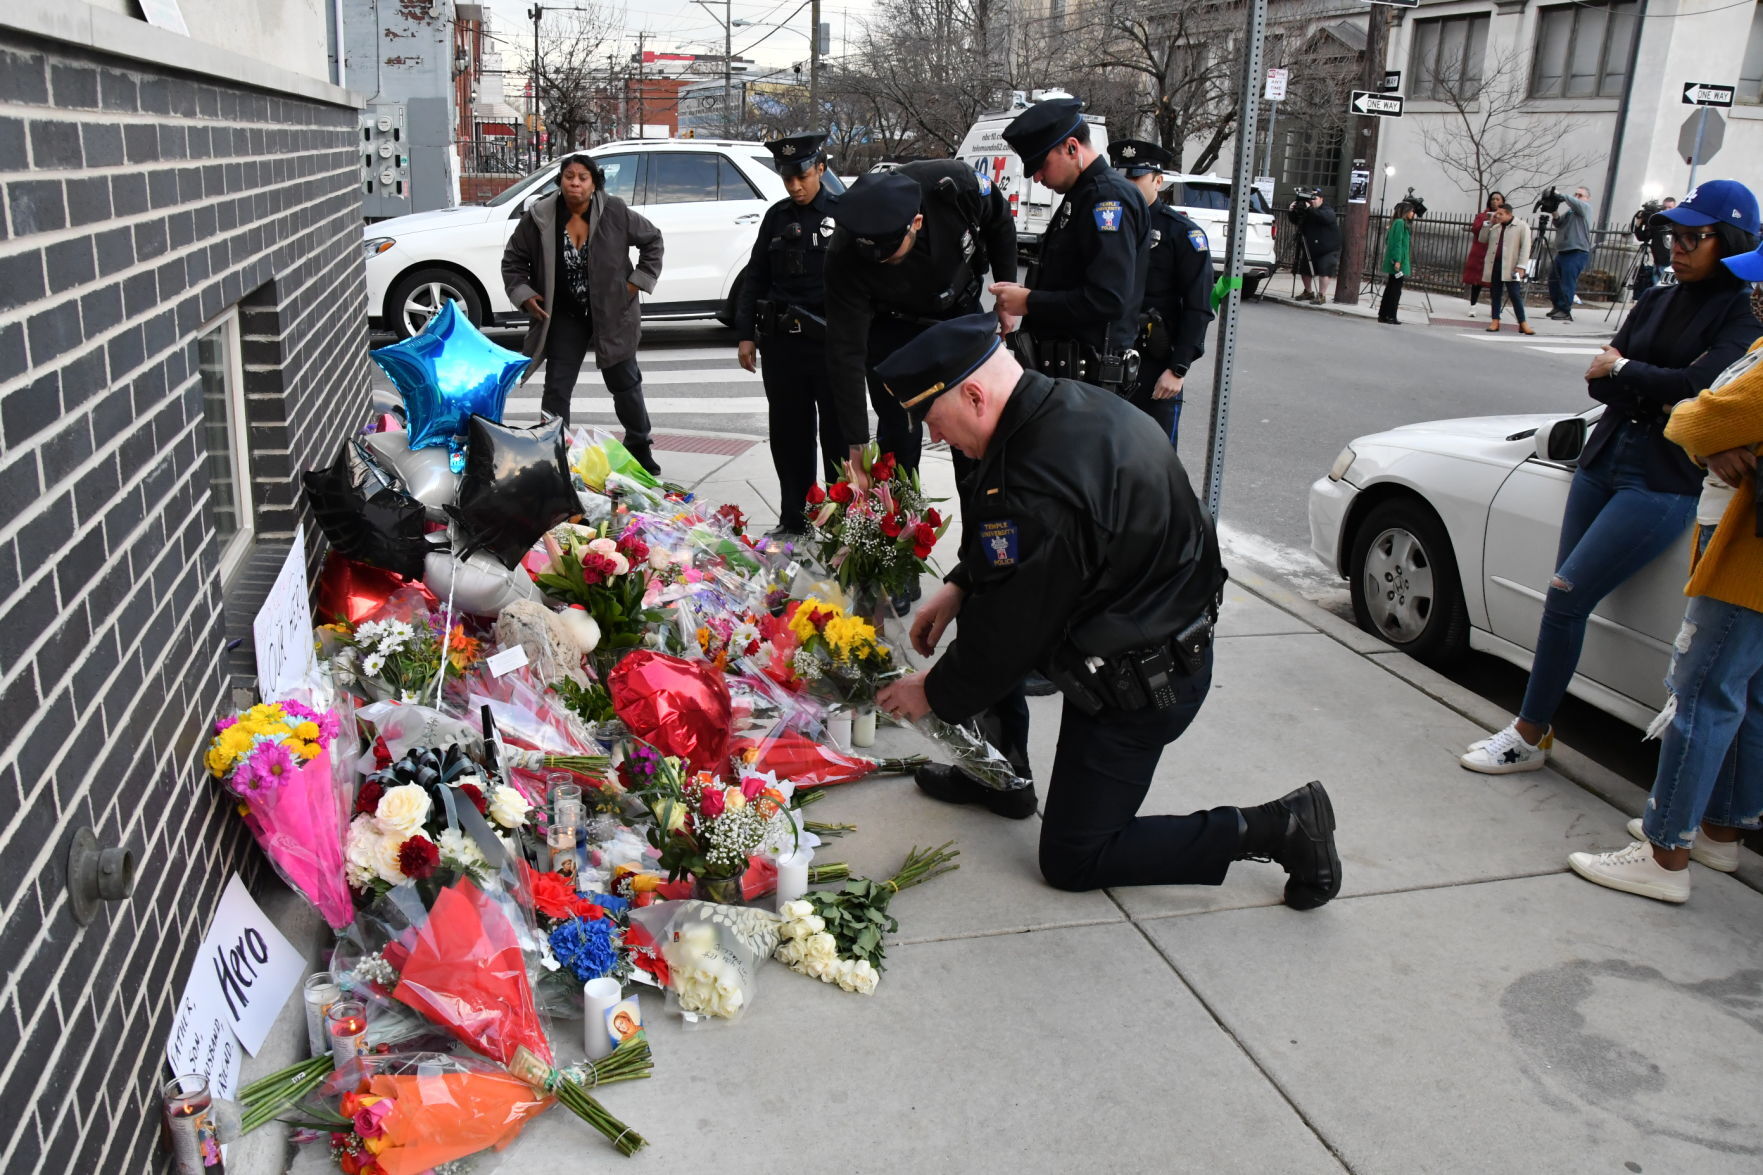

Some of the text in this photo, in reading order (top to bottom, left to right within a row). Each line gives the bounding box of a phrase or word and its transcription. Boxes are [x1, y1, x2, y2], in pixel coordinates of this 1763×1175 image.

[1697, 90, 1729, 101] ONE WAY
[1367, 99, 1399, 111] ONE WAY
[999, 175, 1010, 191] 62
[213, 927, 268, 1023] Hero
